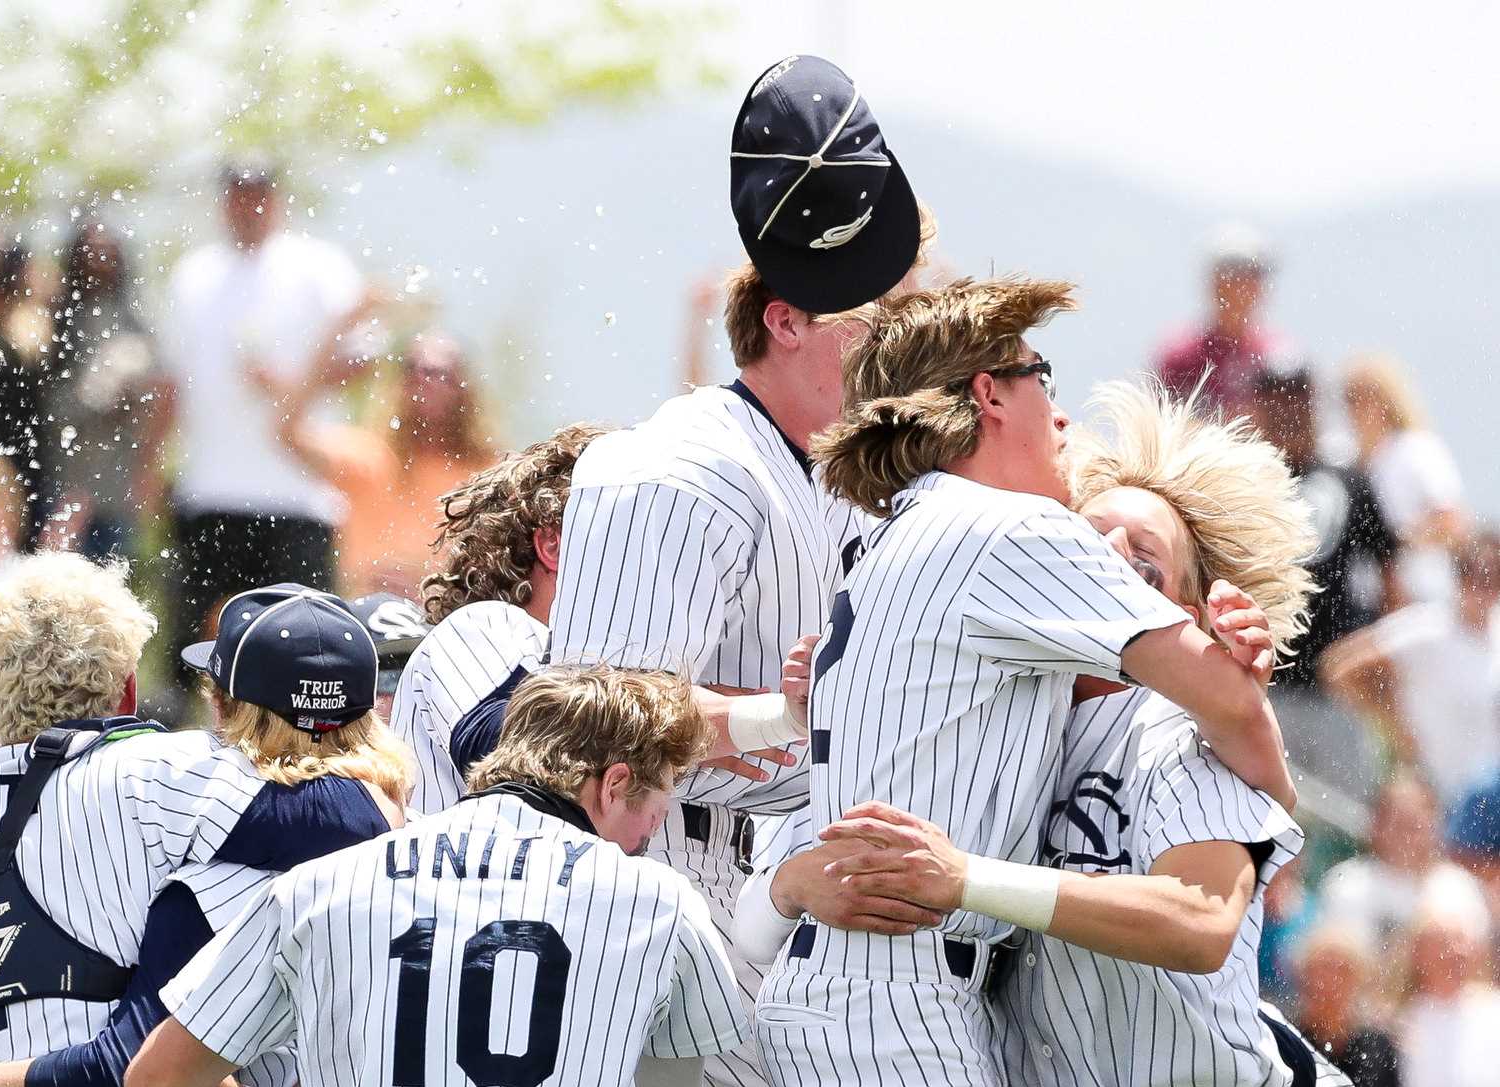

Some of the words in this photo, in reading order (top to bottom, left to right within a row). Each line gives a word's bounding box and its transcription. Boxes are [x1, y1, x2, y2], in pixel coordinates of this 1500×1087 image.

[300, 680, 343, 695] TRUE
[291, 694, 347, 709] WARRIOR
[386, 832, 595, 887] UNITY
